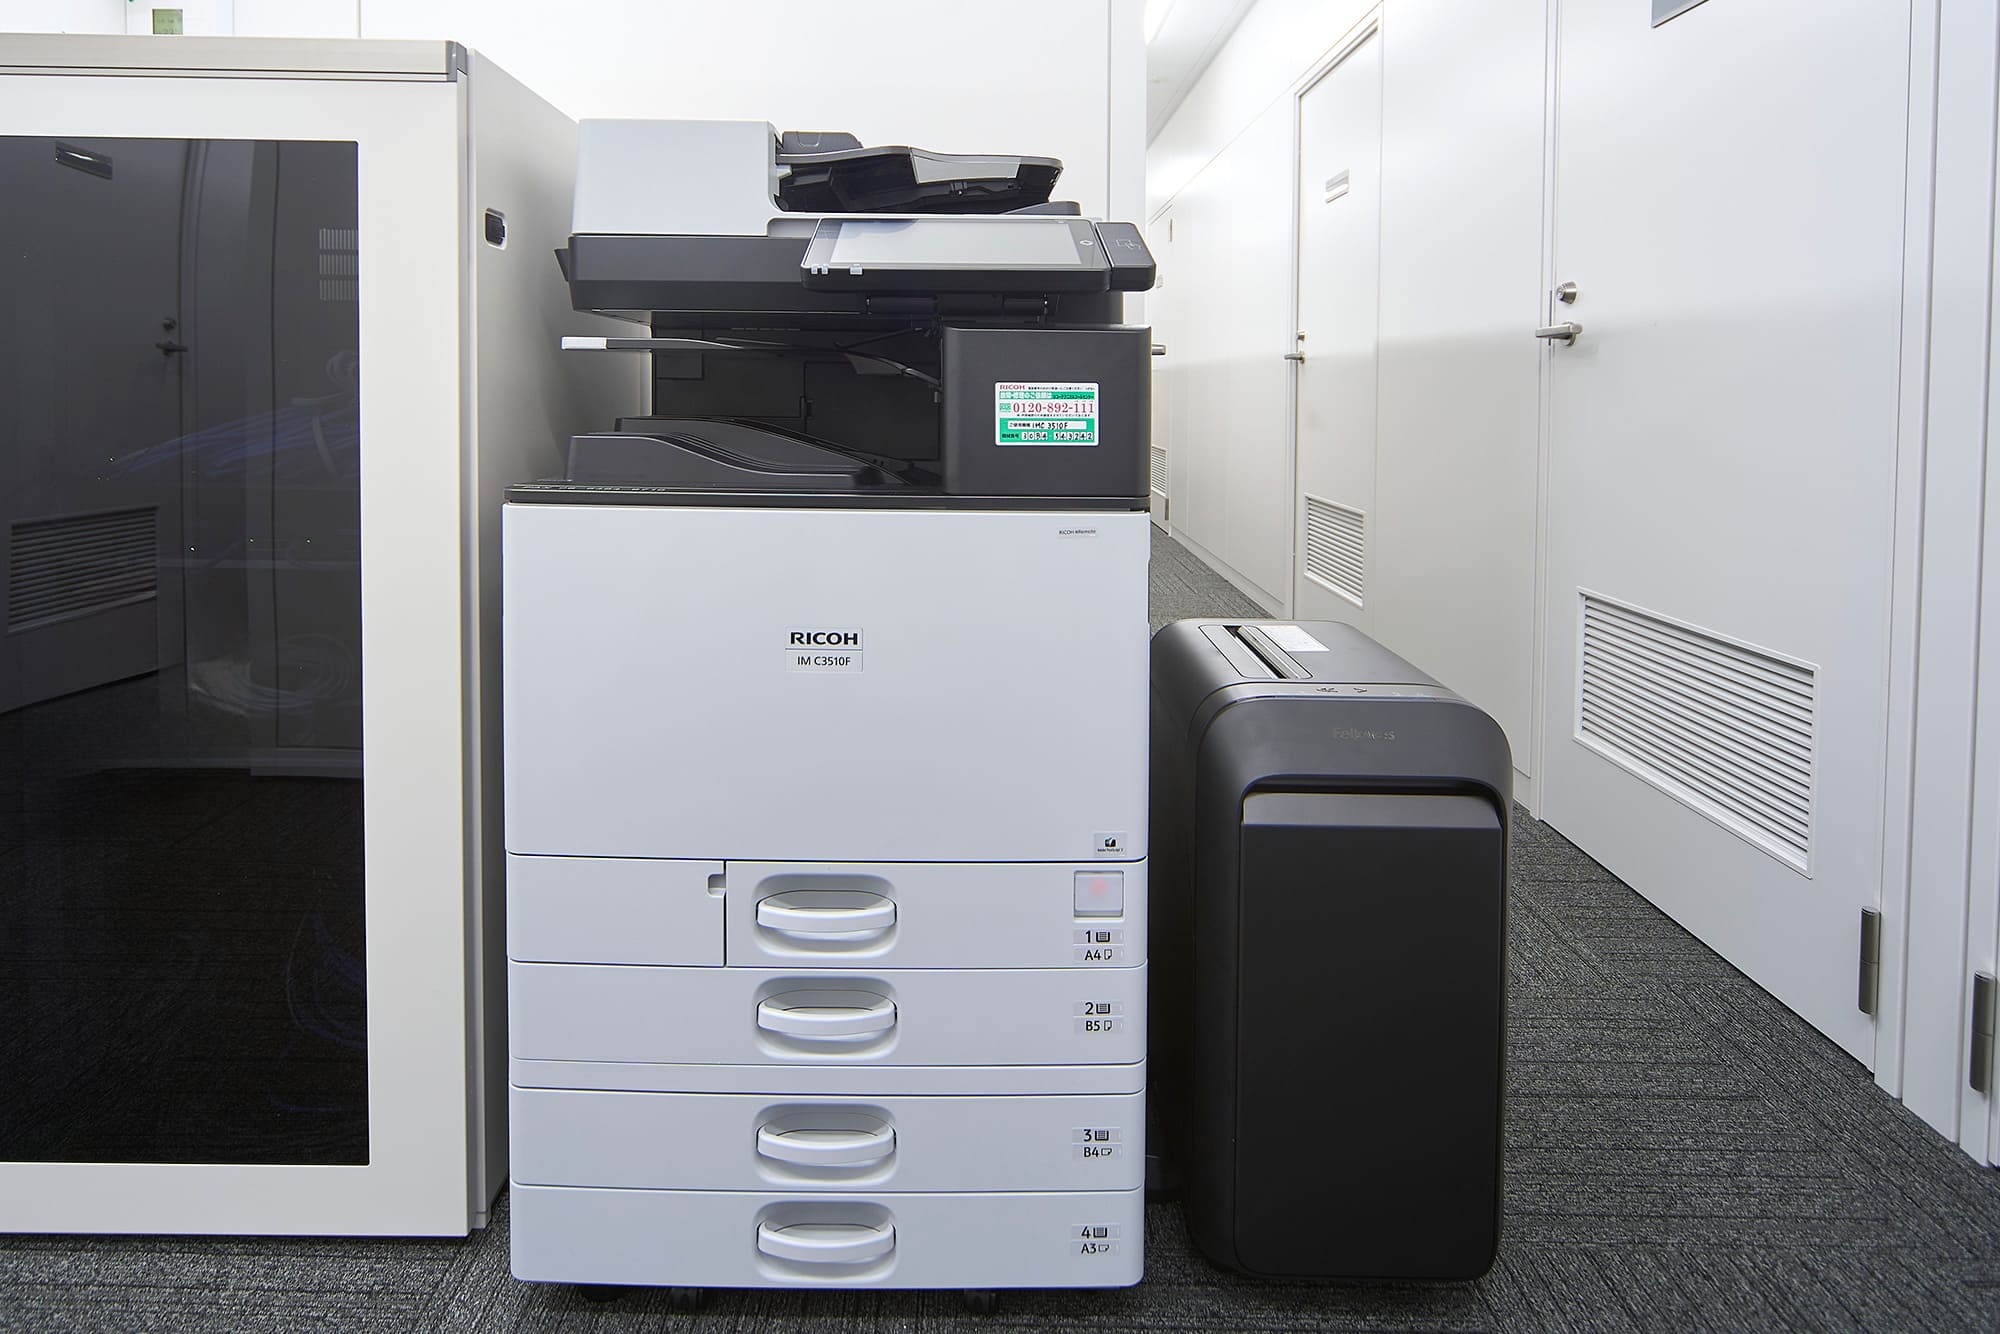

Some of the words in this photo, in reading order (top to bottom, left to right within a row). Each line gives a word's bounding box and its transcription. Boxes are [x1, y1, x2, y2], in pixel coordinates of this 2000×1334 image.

[1013, 402, 1094, 413] 0120-892-111
[790, 632, 858, 645] RICOH
[797, 656, 811, 666] IM
[814, 656, 851, 666] C3510F
[1085, 930, 1091, 943] 1
[1085, 949, 1101, 960] A4
[1085, 1002, 1093, 1015] 2
[1086, 1020, 1100, 1031] B5
[1083, 1129, 1092, 1142] 3
[1083, 1147, 1099, 1157] B4
[1081, 1226, 1091, 1239] 4
[1081, 1243, 1097, 1254] A3
